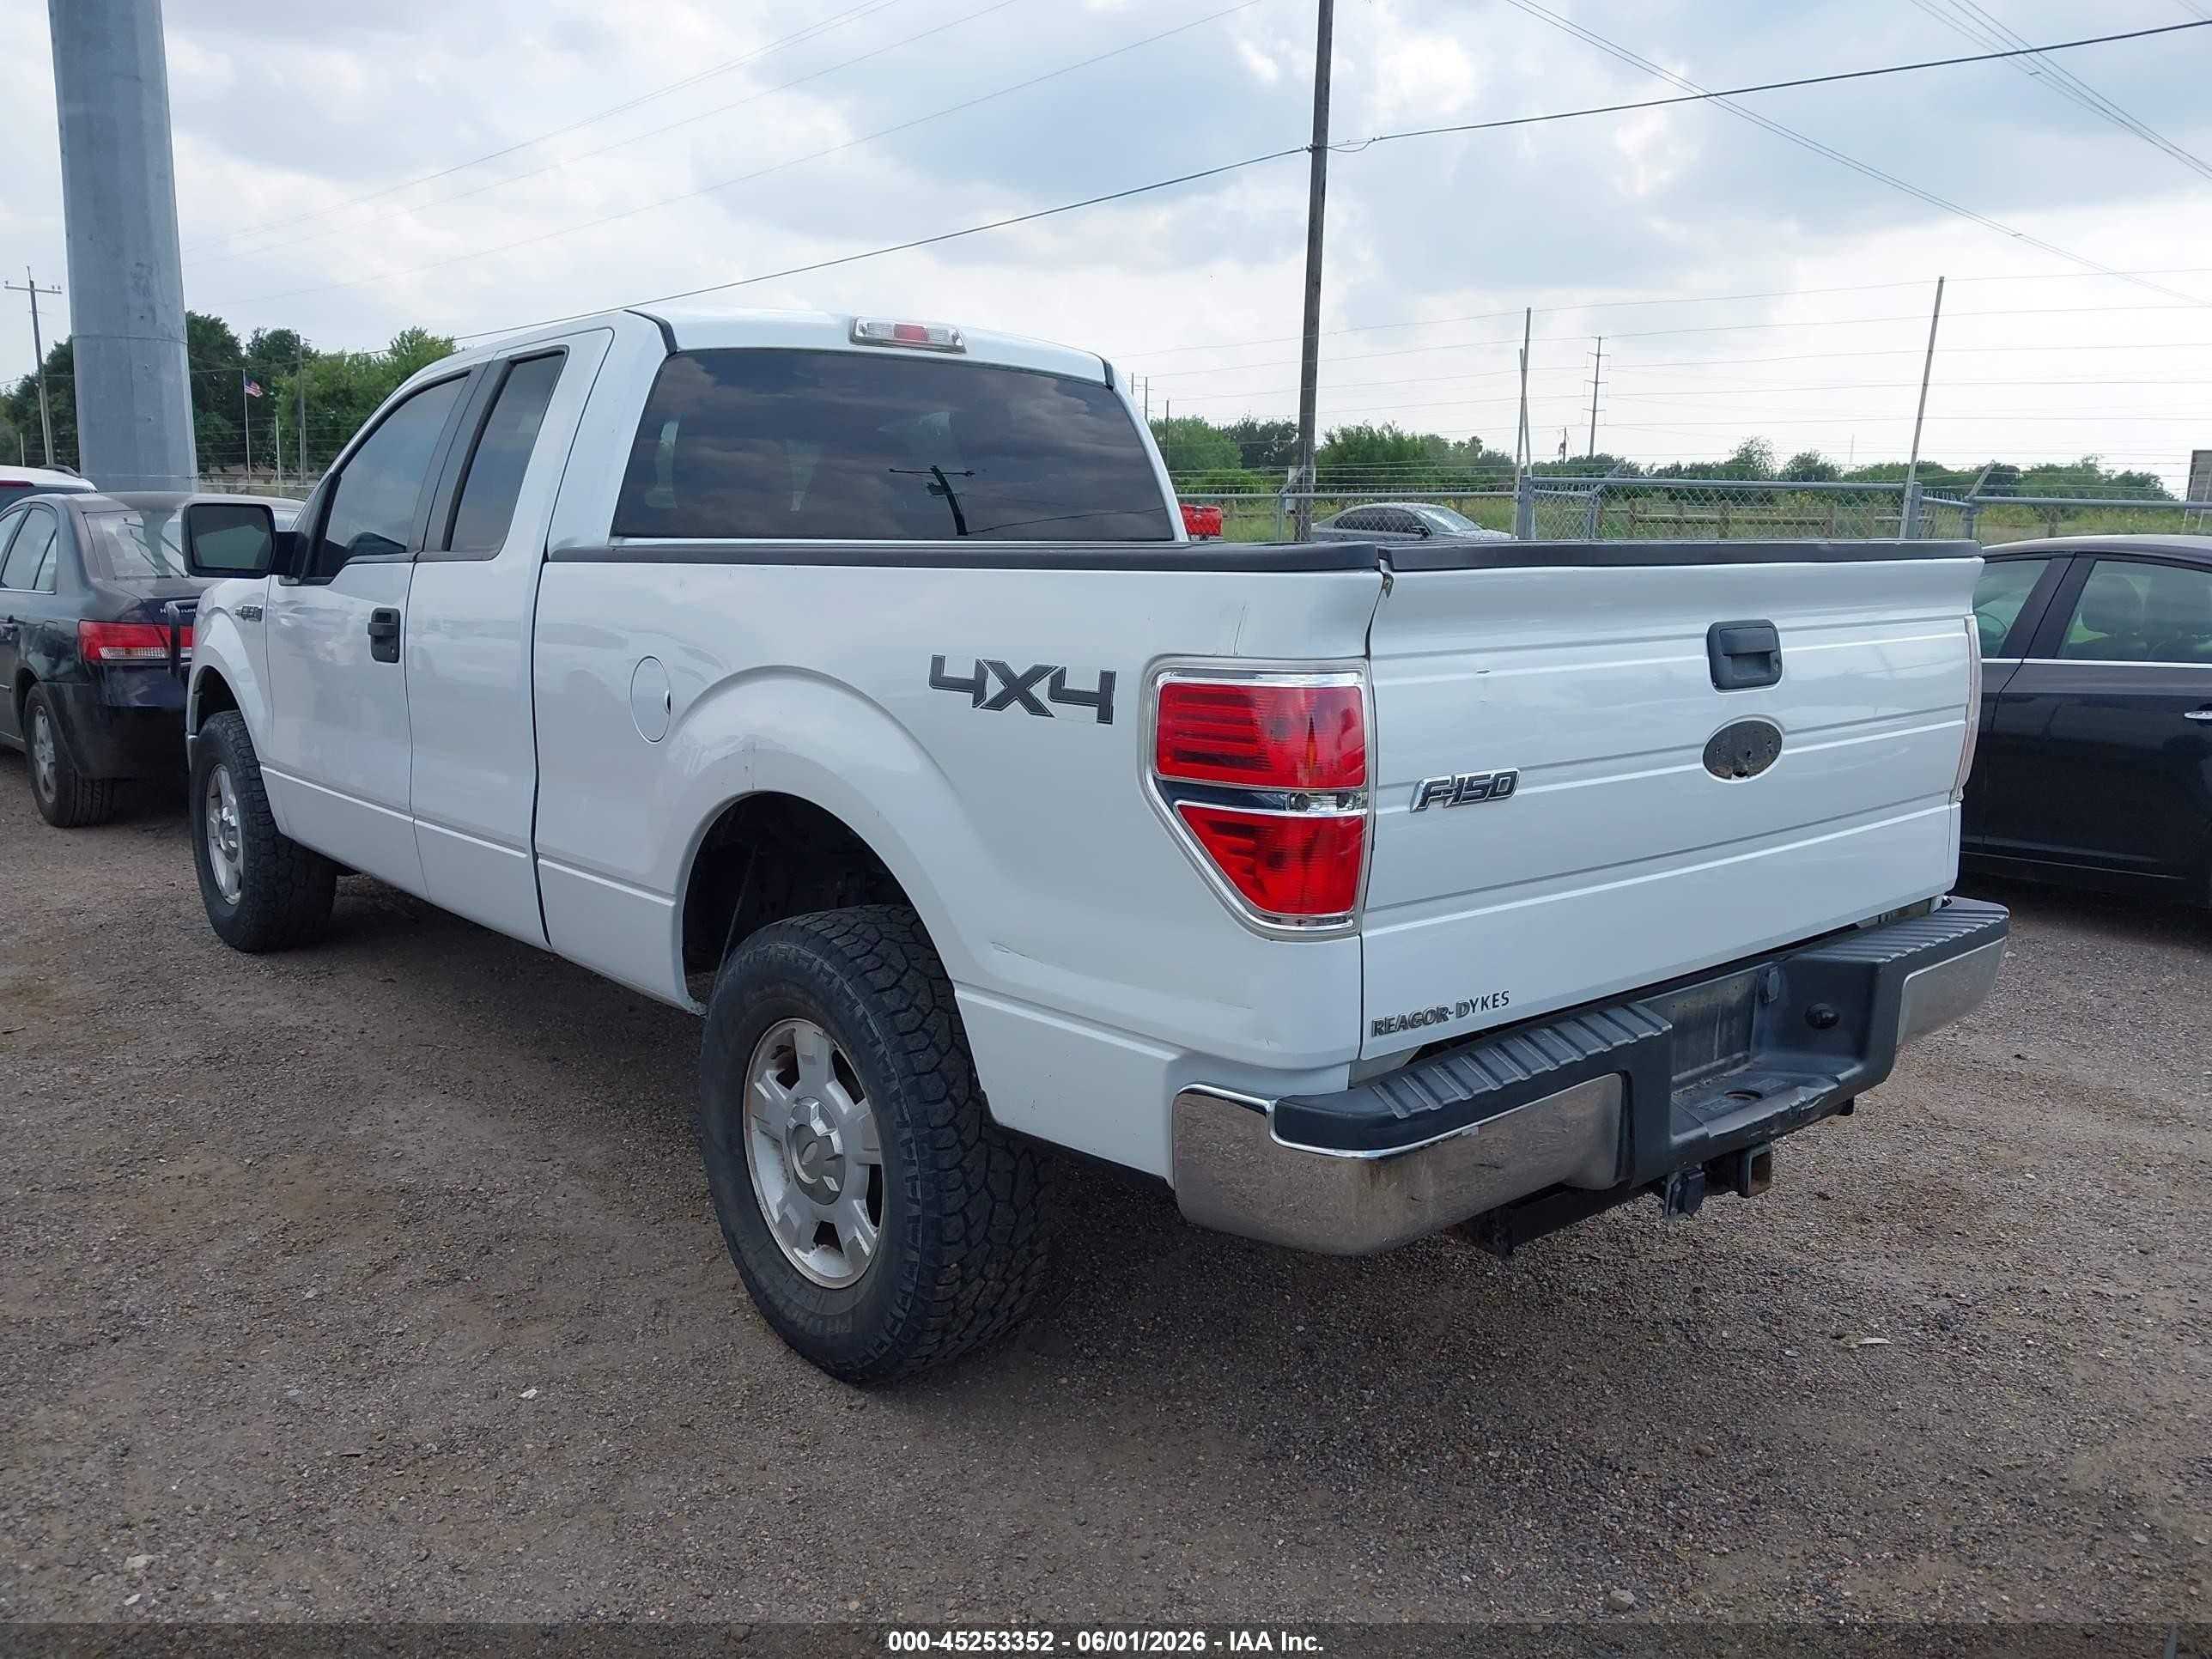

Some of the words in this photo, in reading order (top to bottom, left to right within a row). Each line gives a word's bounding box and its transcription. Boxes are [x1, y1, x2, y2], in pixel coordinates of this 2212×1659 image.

[929, 654, 1116, 725] 4X4
[1410, 769, 1520, 813] F-150
[1371, 990, 1510, 1037] REAGOR-DYKES
